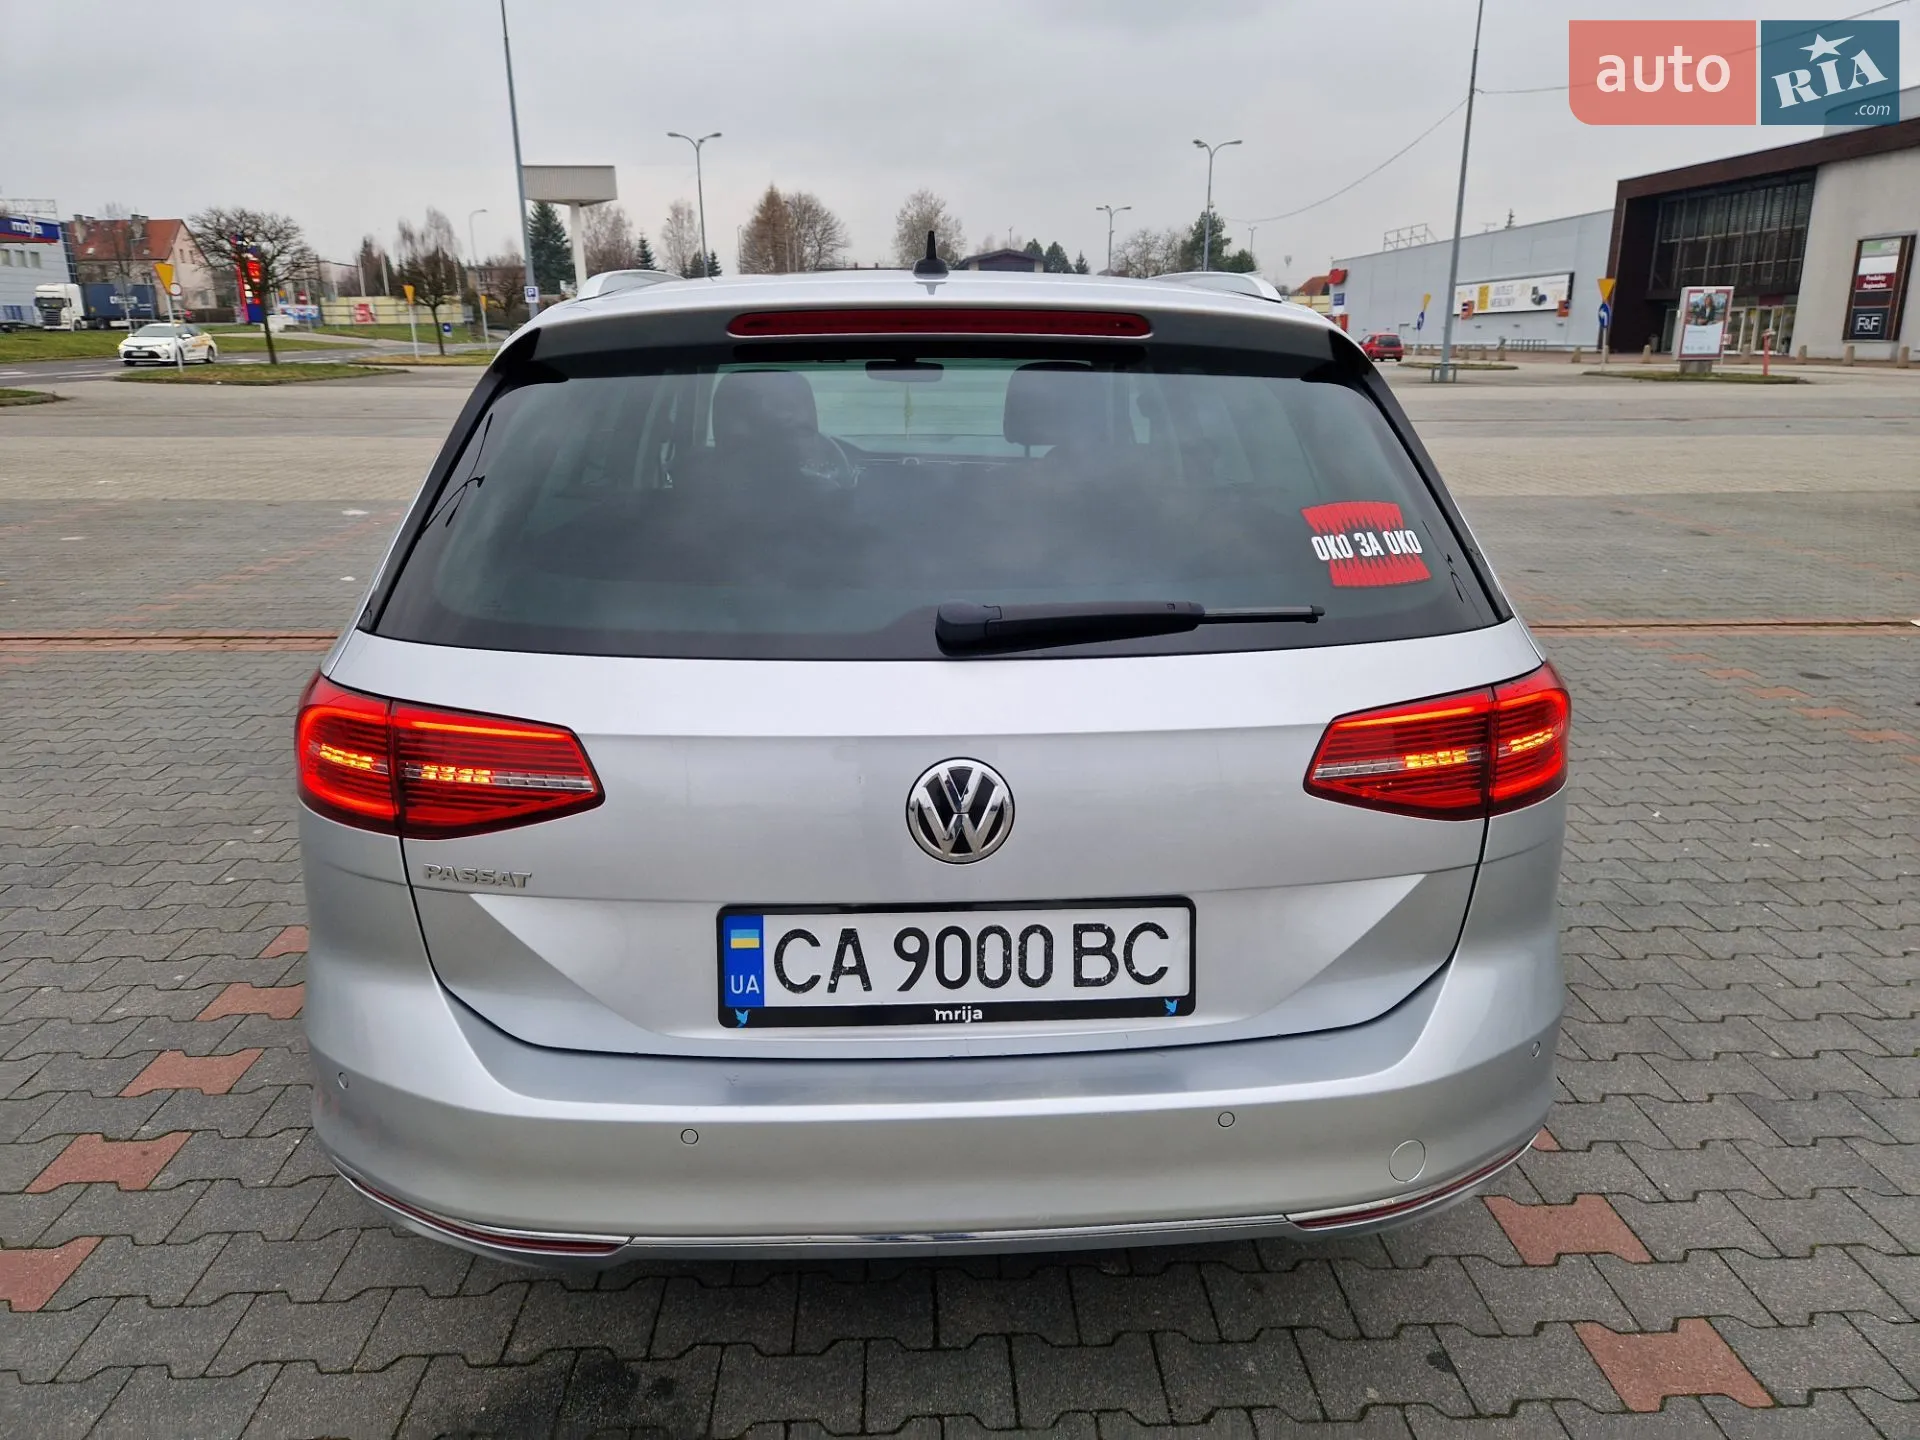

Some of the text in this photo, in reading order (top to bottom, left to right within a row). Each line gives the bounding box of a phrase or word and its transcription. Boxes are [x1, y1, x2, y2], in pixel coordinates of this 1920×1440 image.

[11, 221, 43, 235] moa
[1856, 316, 1880, 331] F&F
[1311, 530, 1423, 561] ОКО ЗА ОКО
[424, 863, 532, 888] PASSAT
[773, 921, 1169, 994] CA 9000 BC
[730, 974, 760, 995] UA
[933, 1005, 983, 1024] mrija
